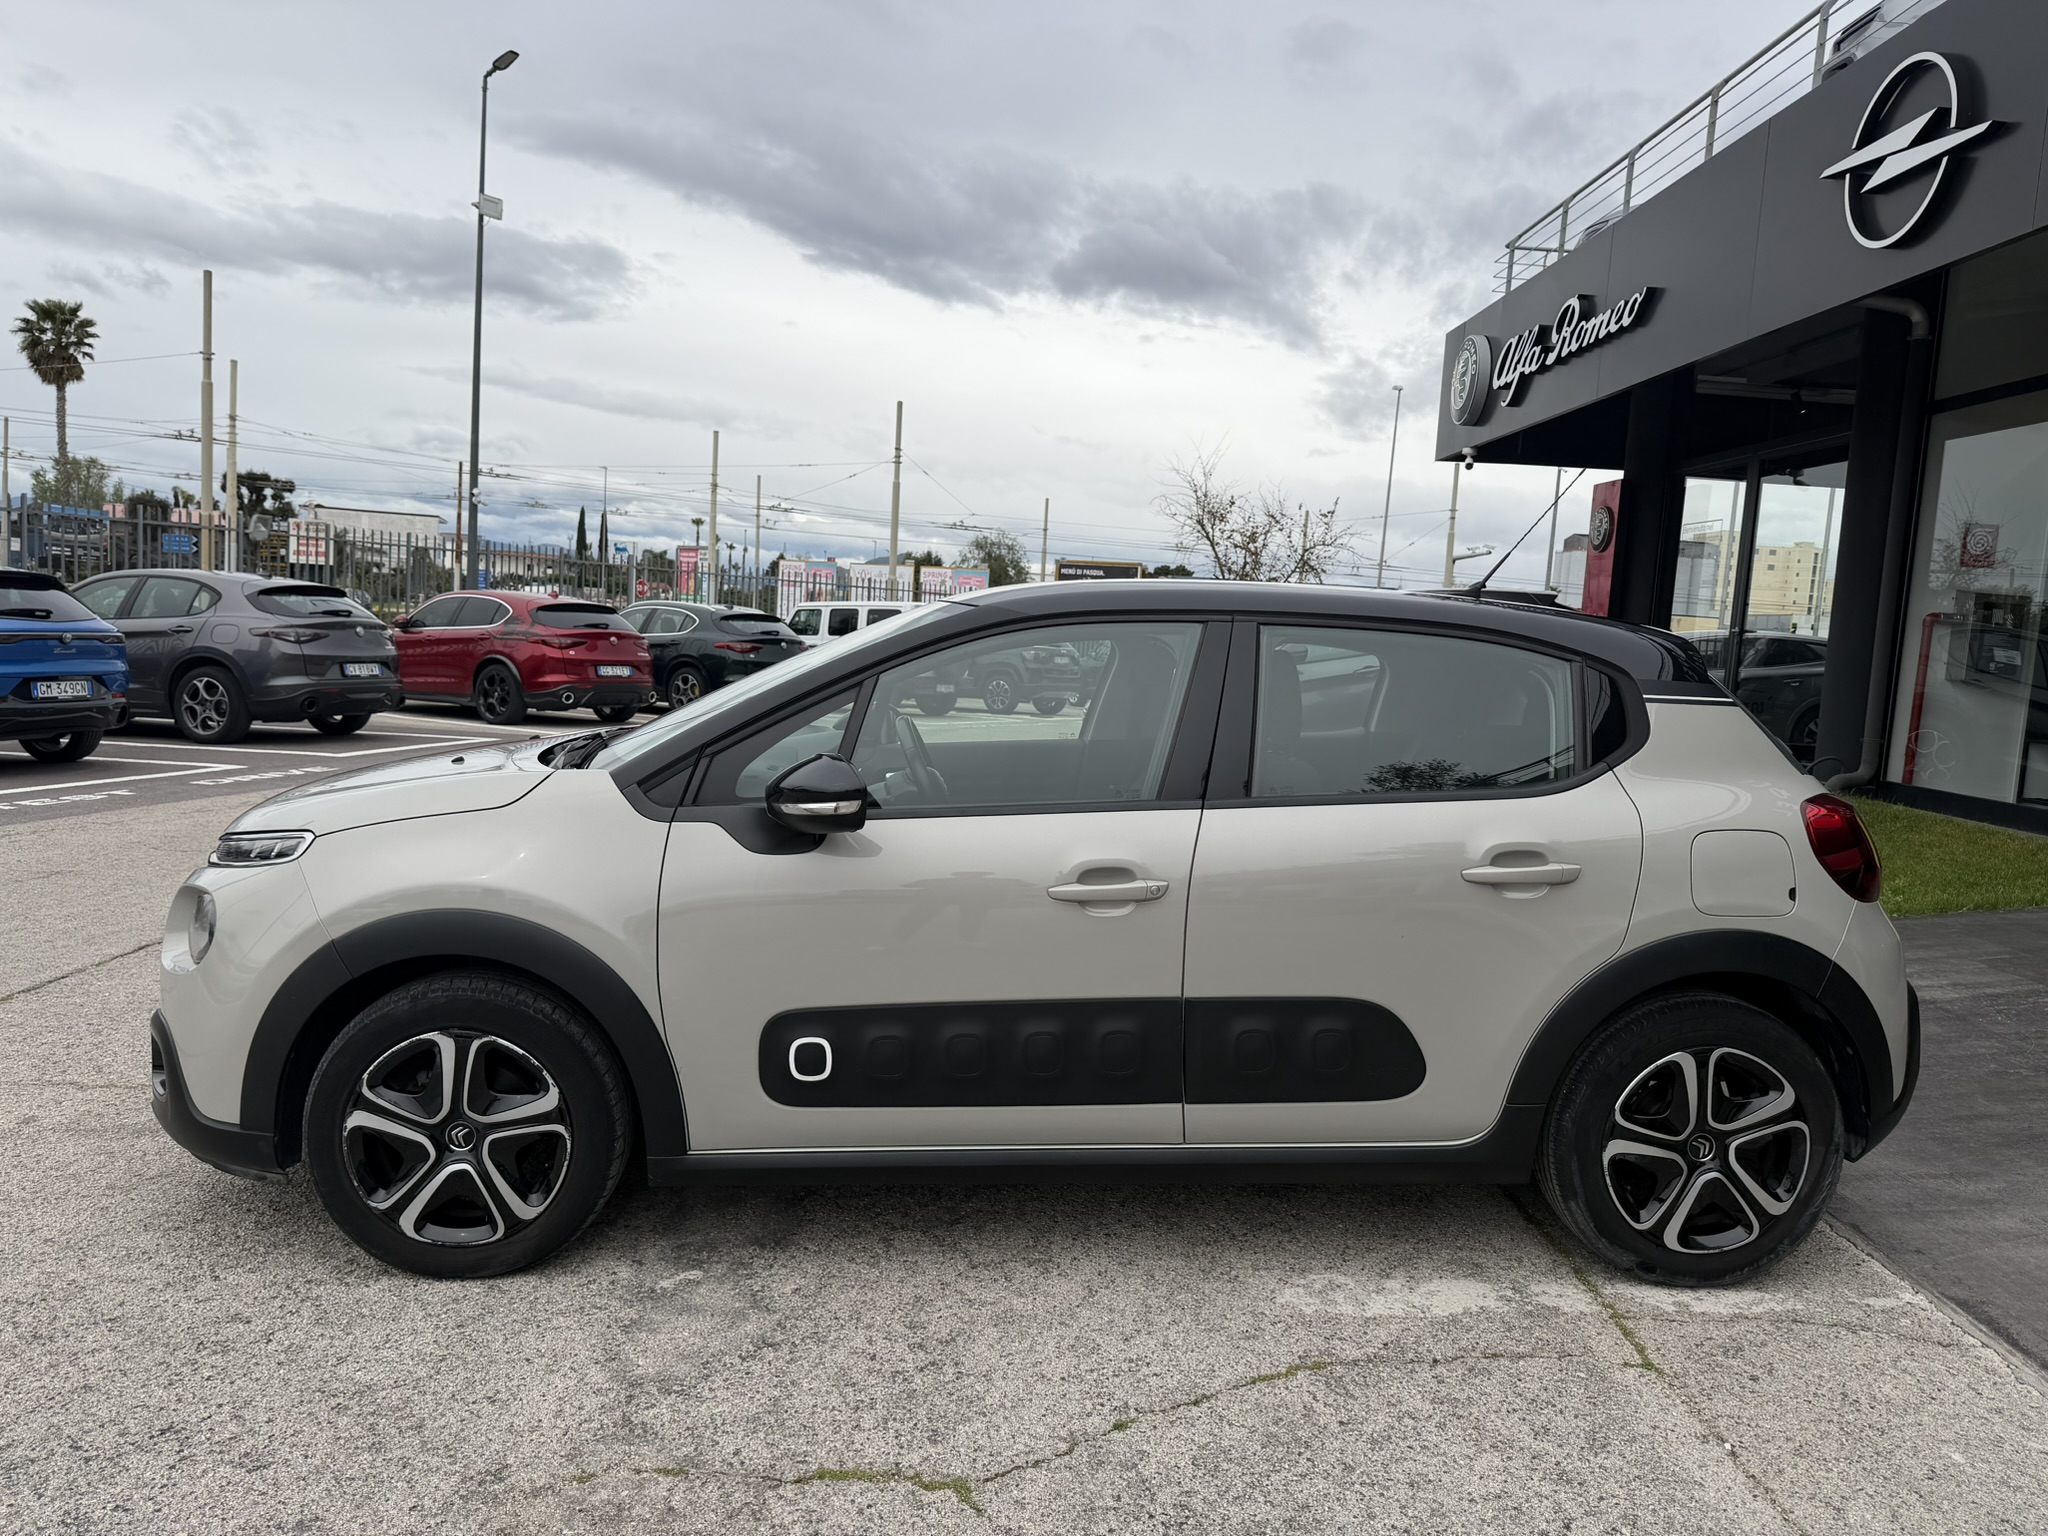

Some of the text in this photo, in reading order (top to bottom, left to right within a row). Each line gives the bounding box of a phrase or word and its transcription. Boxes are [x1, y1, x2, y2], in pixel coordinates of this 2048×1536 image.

[1492, 323, 1545, 407] Alfa
[1545, 286, 1647, 366] Romeo
[922, 571, 948, 579] SPRING
[1060, 567, 1076, 575] MENÙ
